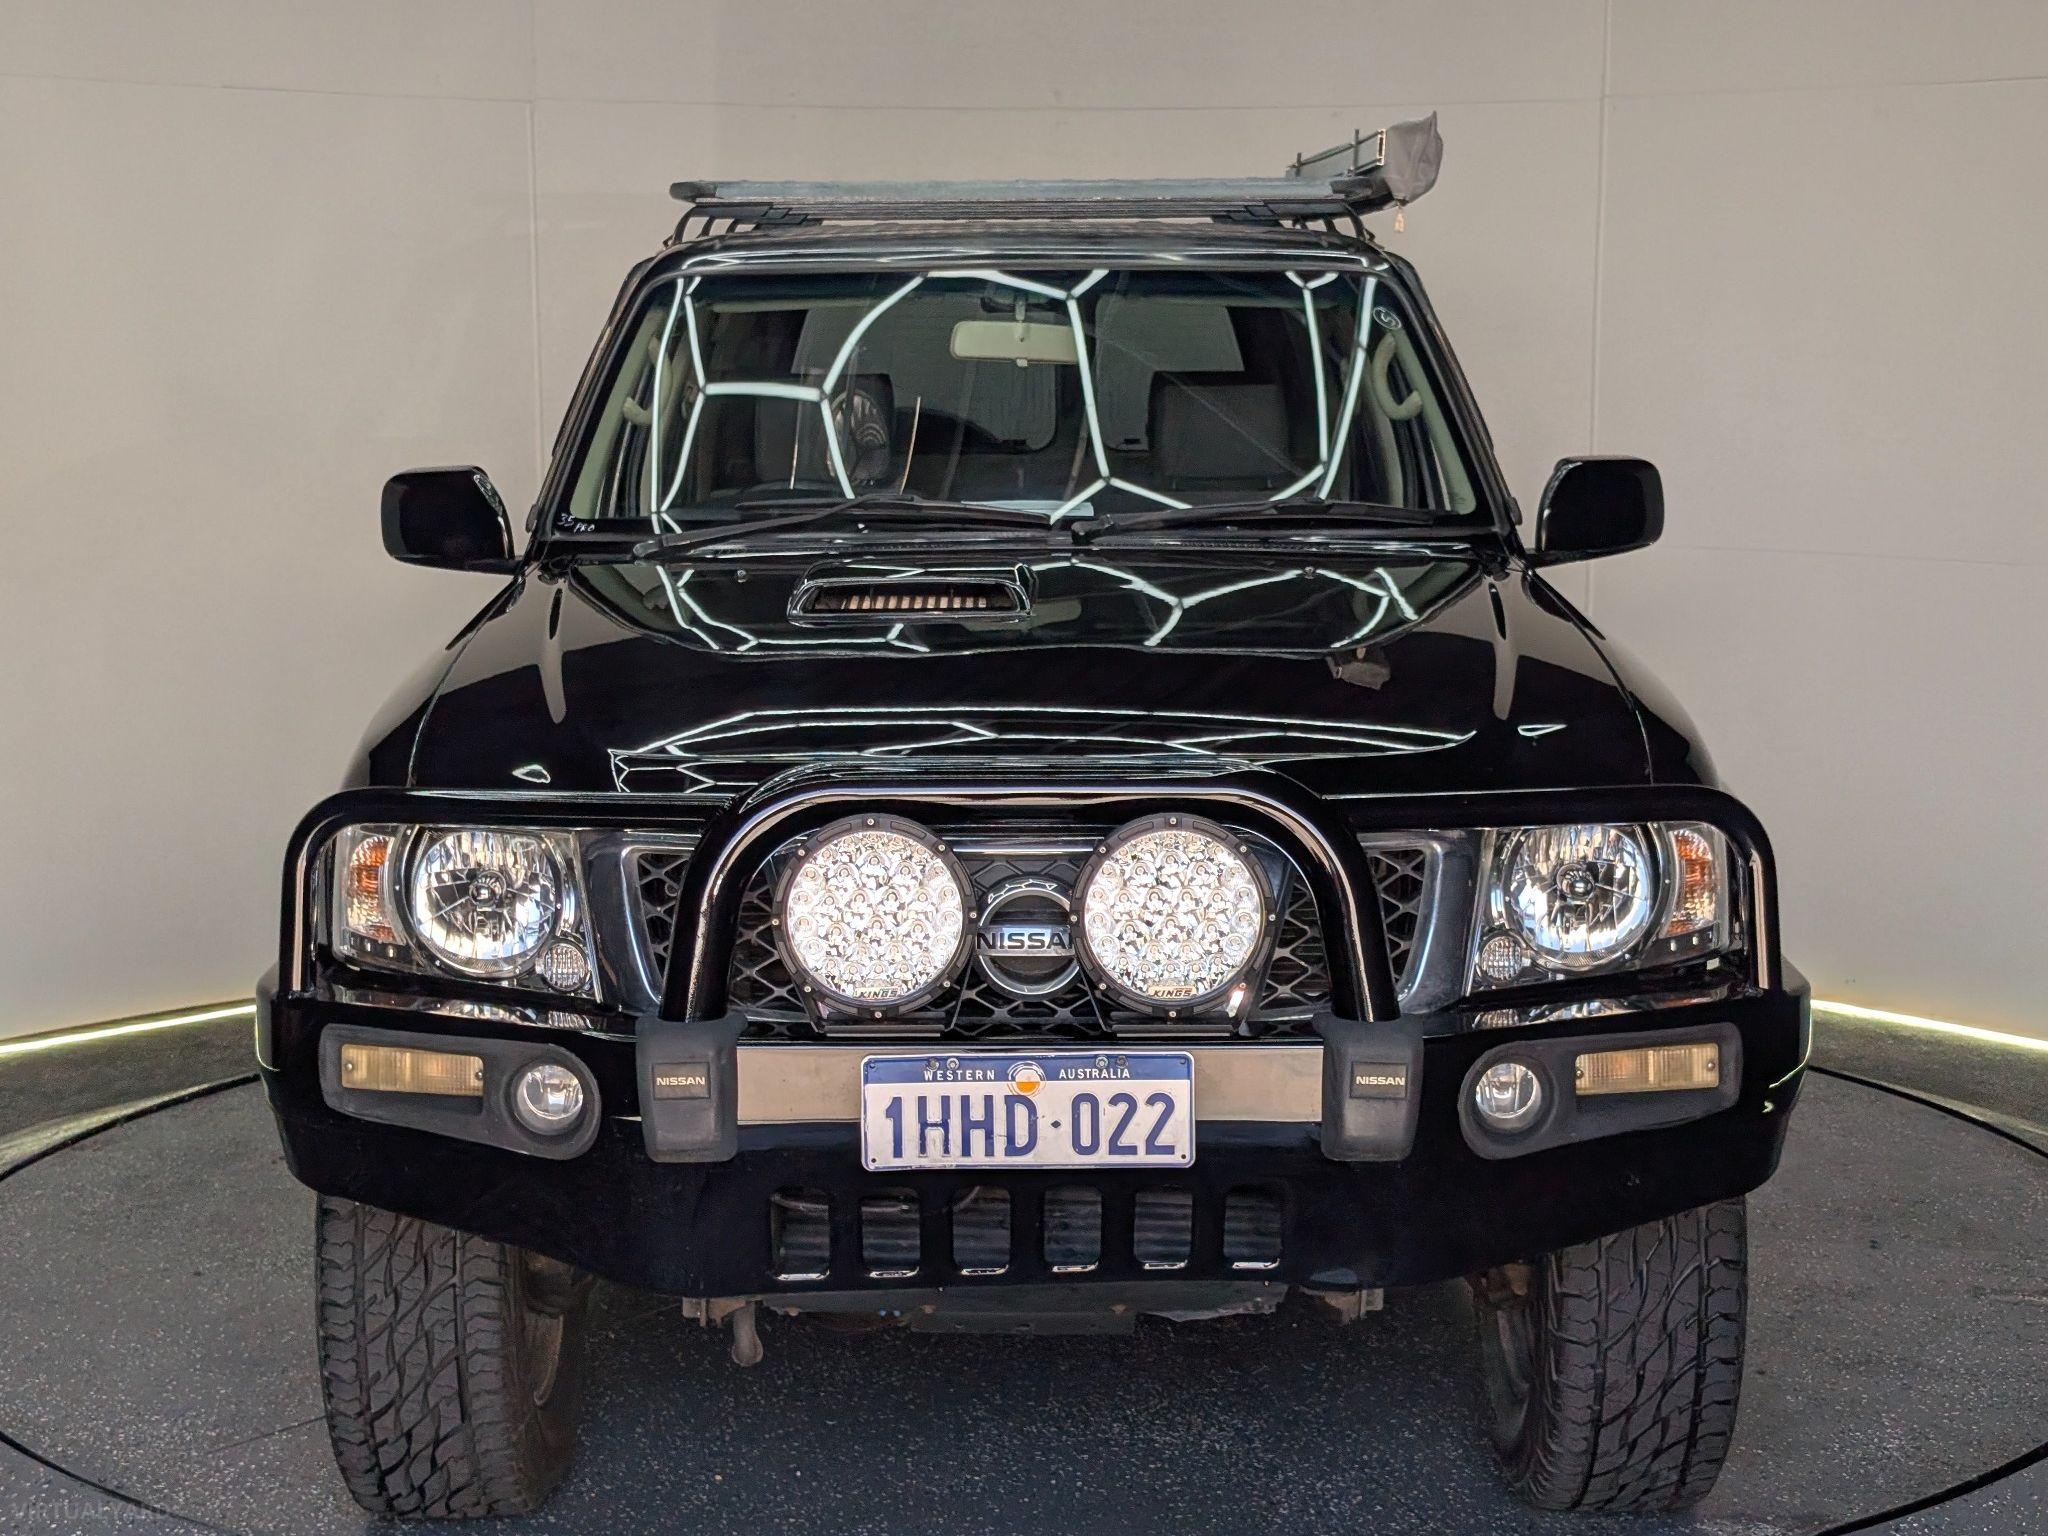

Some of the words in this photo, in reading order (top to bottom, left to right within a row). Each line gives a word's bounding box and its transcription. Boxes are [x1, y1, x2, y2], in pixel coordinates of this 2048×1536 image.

[860, 990, 898, 999] KINGS
[1152, 988, 1192, 998] KINGS
[923, 1069, 995, 1081] WESTERN
[1058, 1068, 1131, 1080] AUSTRALIA
[656, 1076, 706, 1086] NISSAN
[1356, 1076, 1406, 1086] NISSAN
